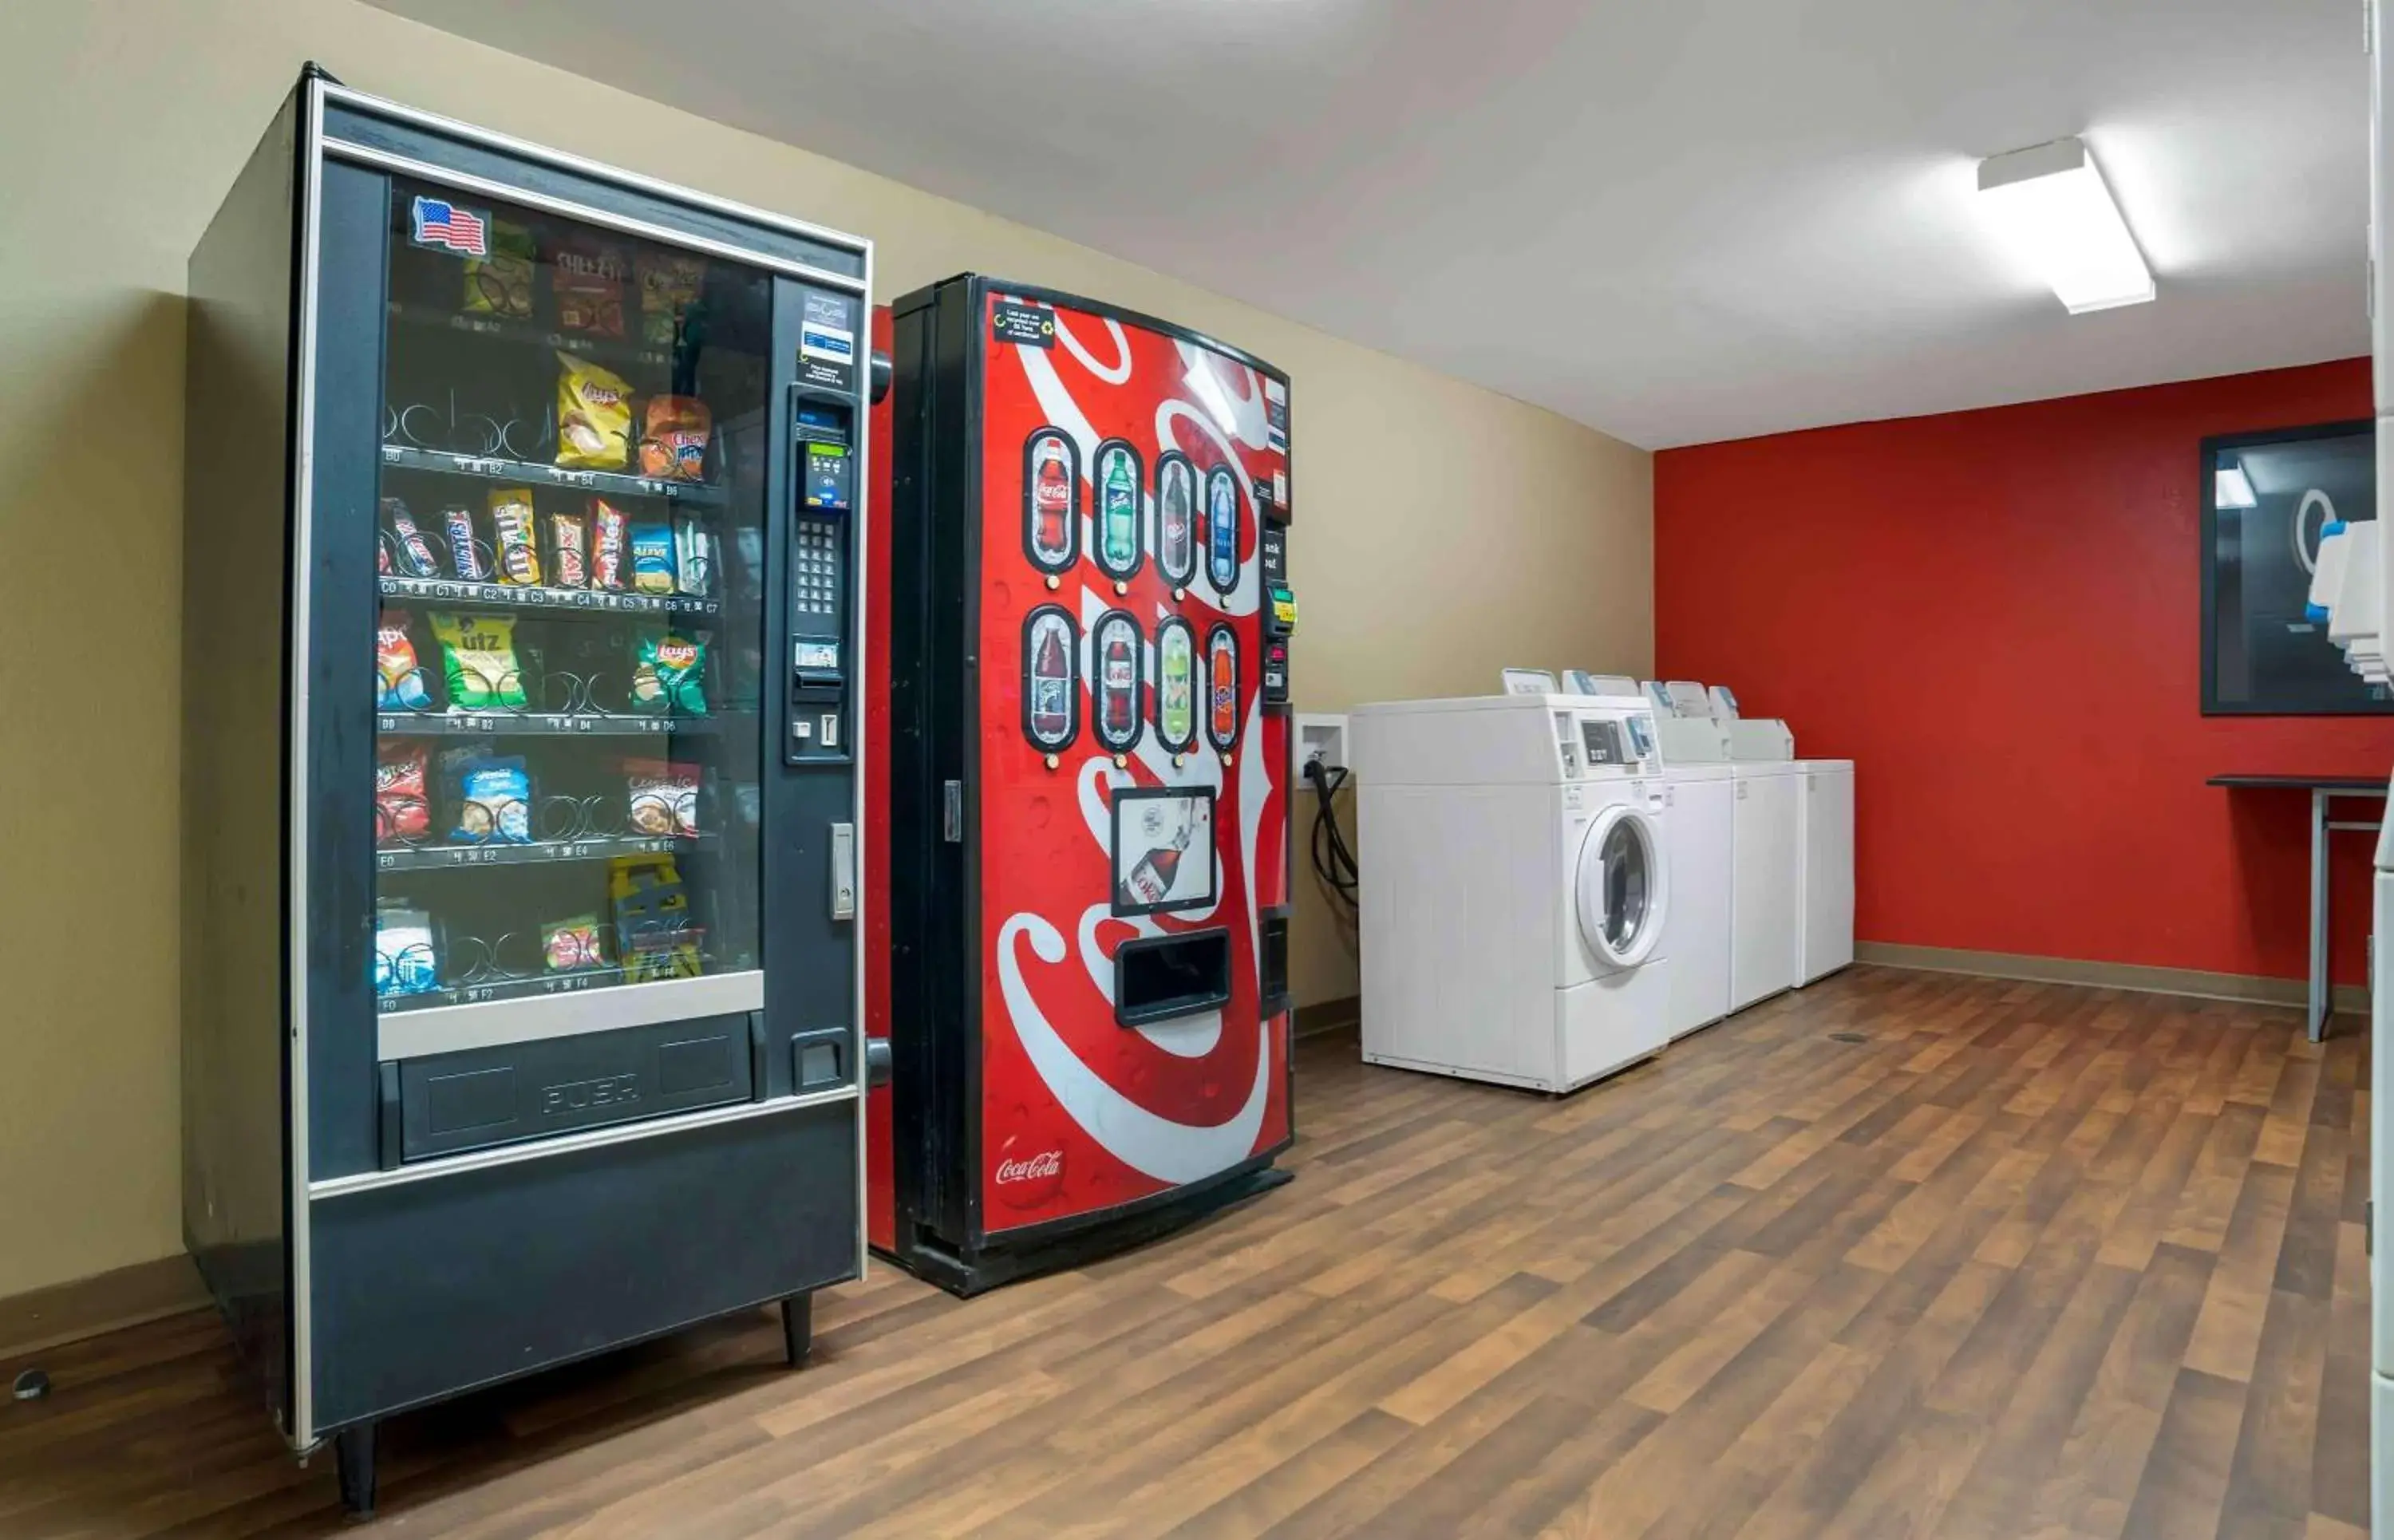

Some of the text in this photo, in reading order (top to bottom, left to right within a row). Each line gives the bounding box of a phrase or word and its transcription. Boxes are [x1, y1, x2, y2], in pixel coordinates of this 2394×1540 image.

[483, 588, 497, 599] C2
[531, 591, 546, 602] C3
[484, 850, 497, 862] E2
